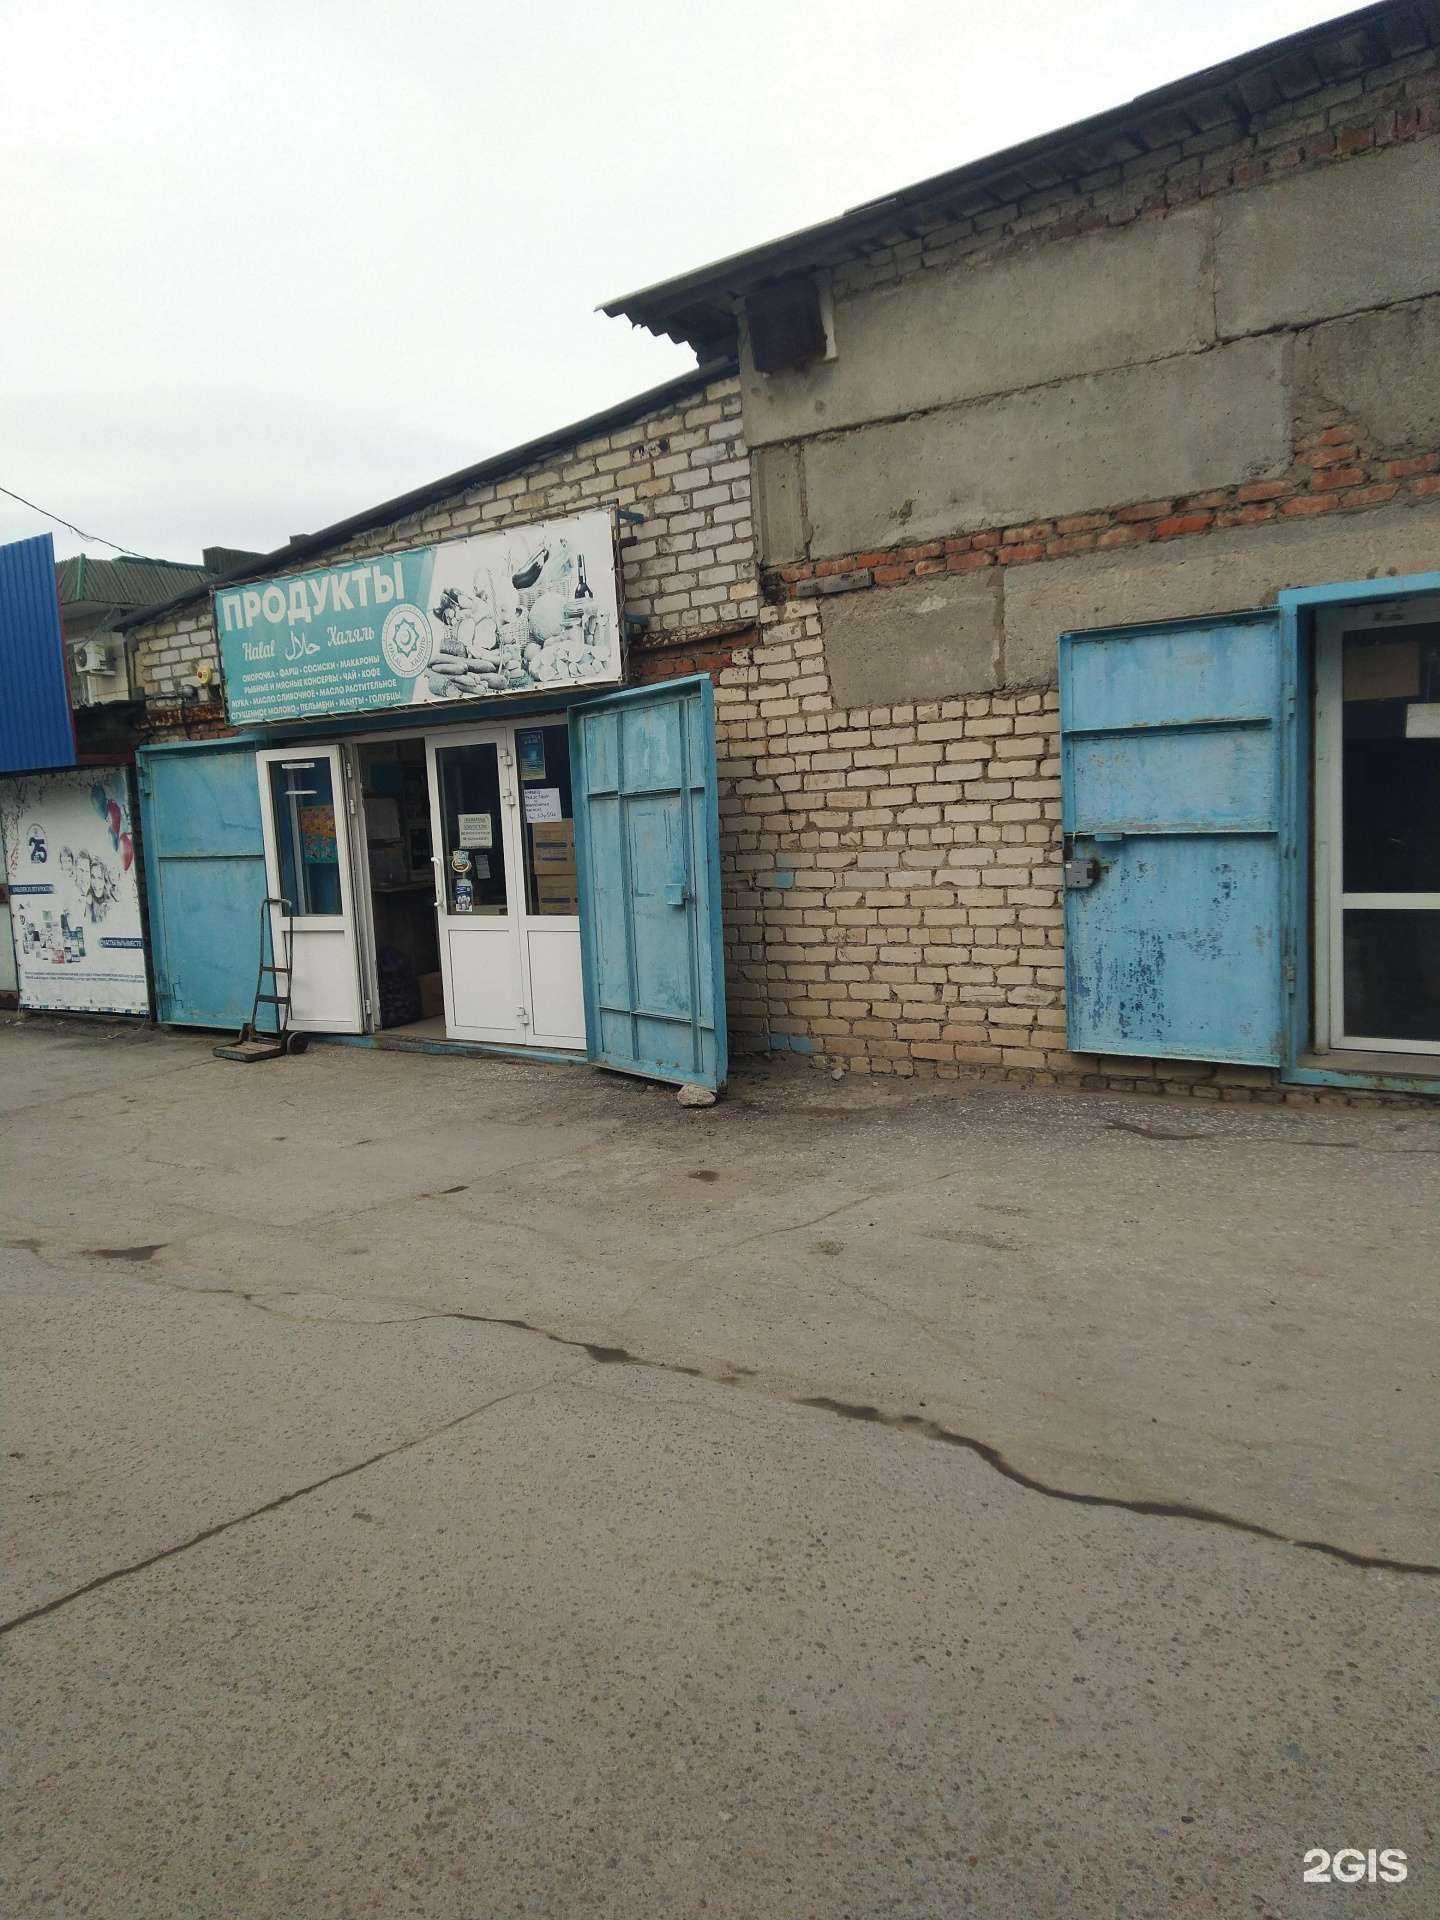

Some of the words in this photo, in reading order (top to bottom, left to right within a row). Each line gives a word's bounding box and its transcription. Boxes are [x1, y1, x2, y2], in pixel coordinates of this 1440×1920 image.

[222, 561, 405, 631] ПРОДУКТЫ
[284, 630, 320, 661] حلال
[327, 624, 375, 647] Халяль
[242, 639, 276, 661] Halal
[242, 670, 275, 682] ОКОРОЧКА
[280, 667, 299, 676] ФАРШ
[303, 661, 336, 673] СОСИСКИ
[340, 655, 379, 667] МАКАРОНЫ
[276, 679, 303, 690] МЯСНЫЕ
[304, 674, 338, 686] КОНСЕРВЫ
[343, 670, 357, 681] ЧАЙ
[362, 668, 381, 677] КОФЕ
[231, 700, 249, 708] МУКА
[253, 695, 276, 705] МАСЛО
[277, 690, 315, 702] СЛИВОЧНОЕ
[319, 685, 344, 696] МАСЛО
[345, 679, 397, 694] РАСТИТЕЛЬНОЕ
[268, 704, 296, 715] МОЛОКО
[300, 701, 334, 711] ПЕЛЬМЕНИ
[339, 697, 364, 706] МАНТЫ
[368, 691, 400, 703] ГОЛУБЦЫ
